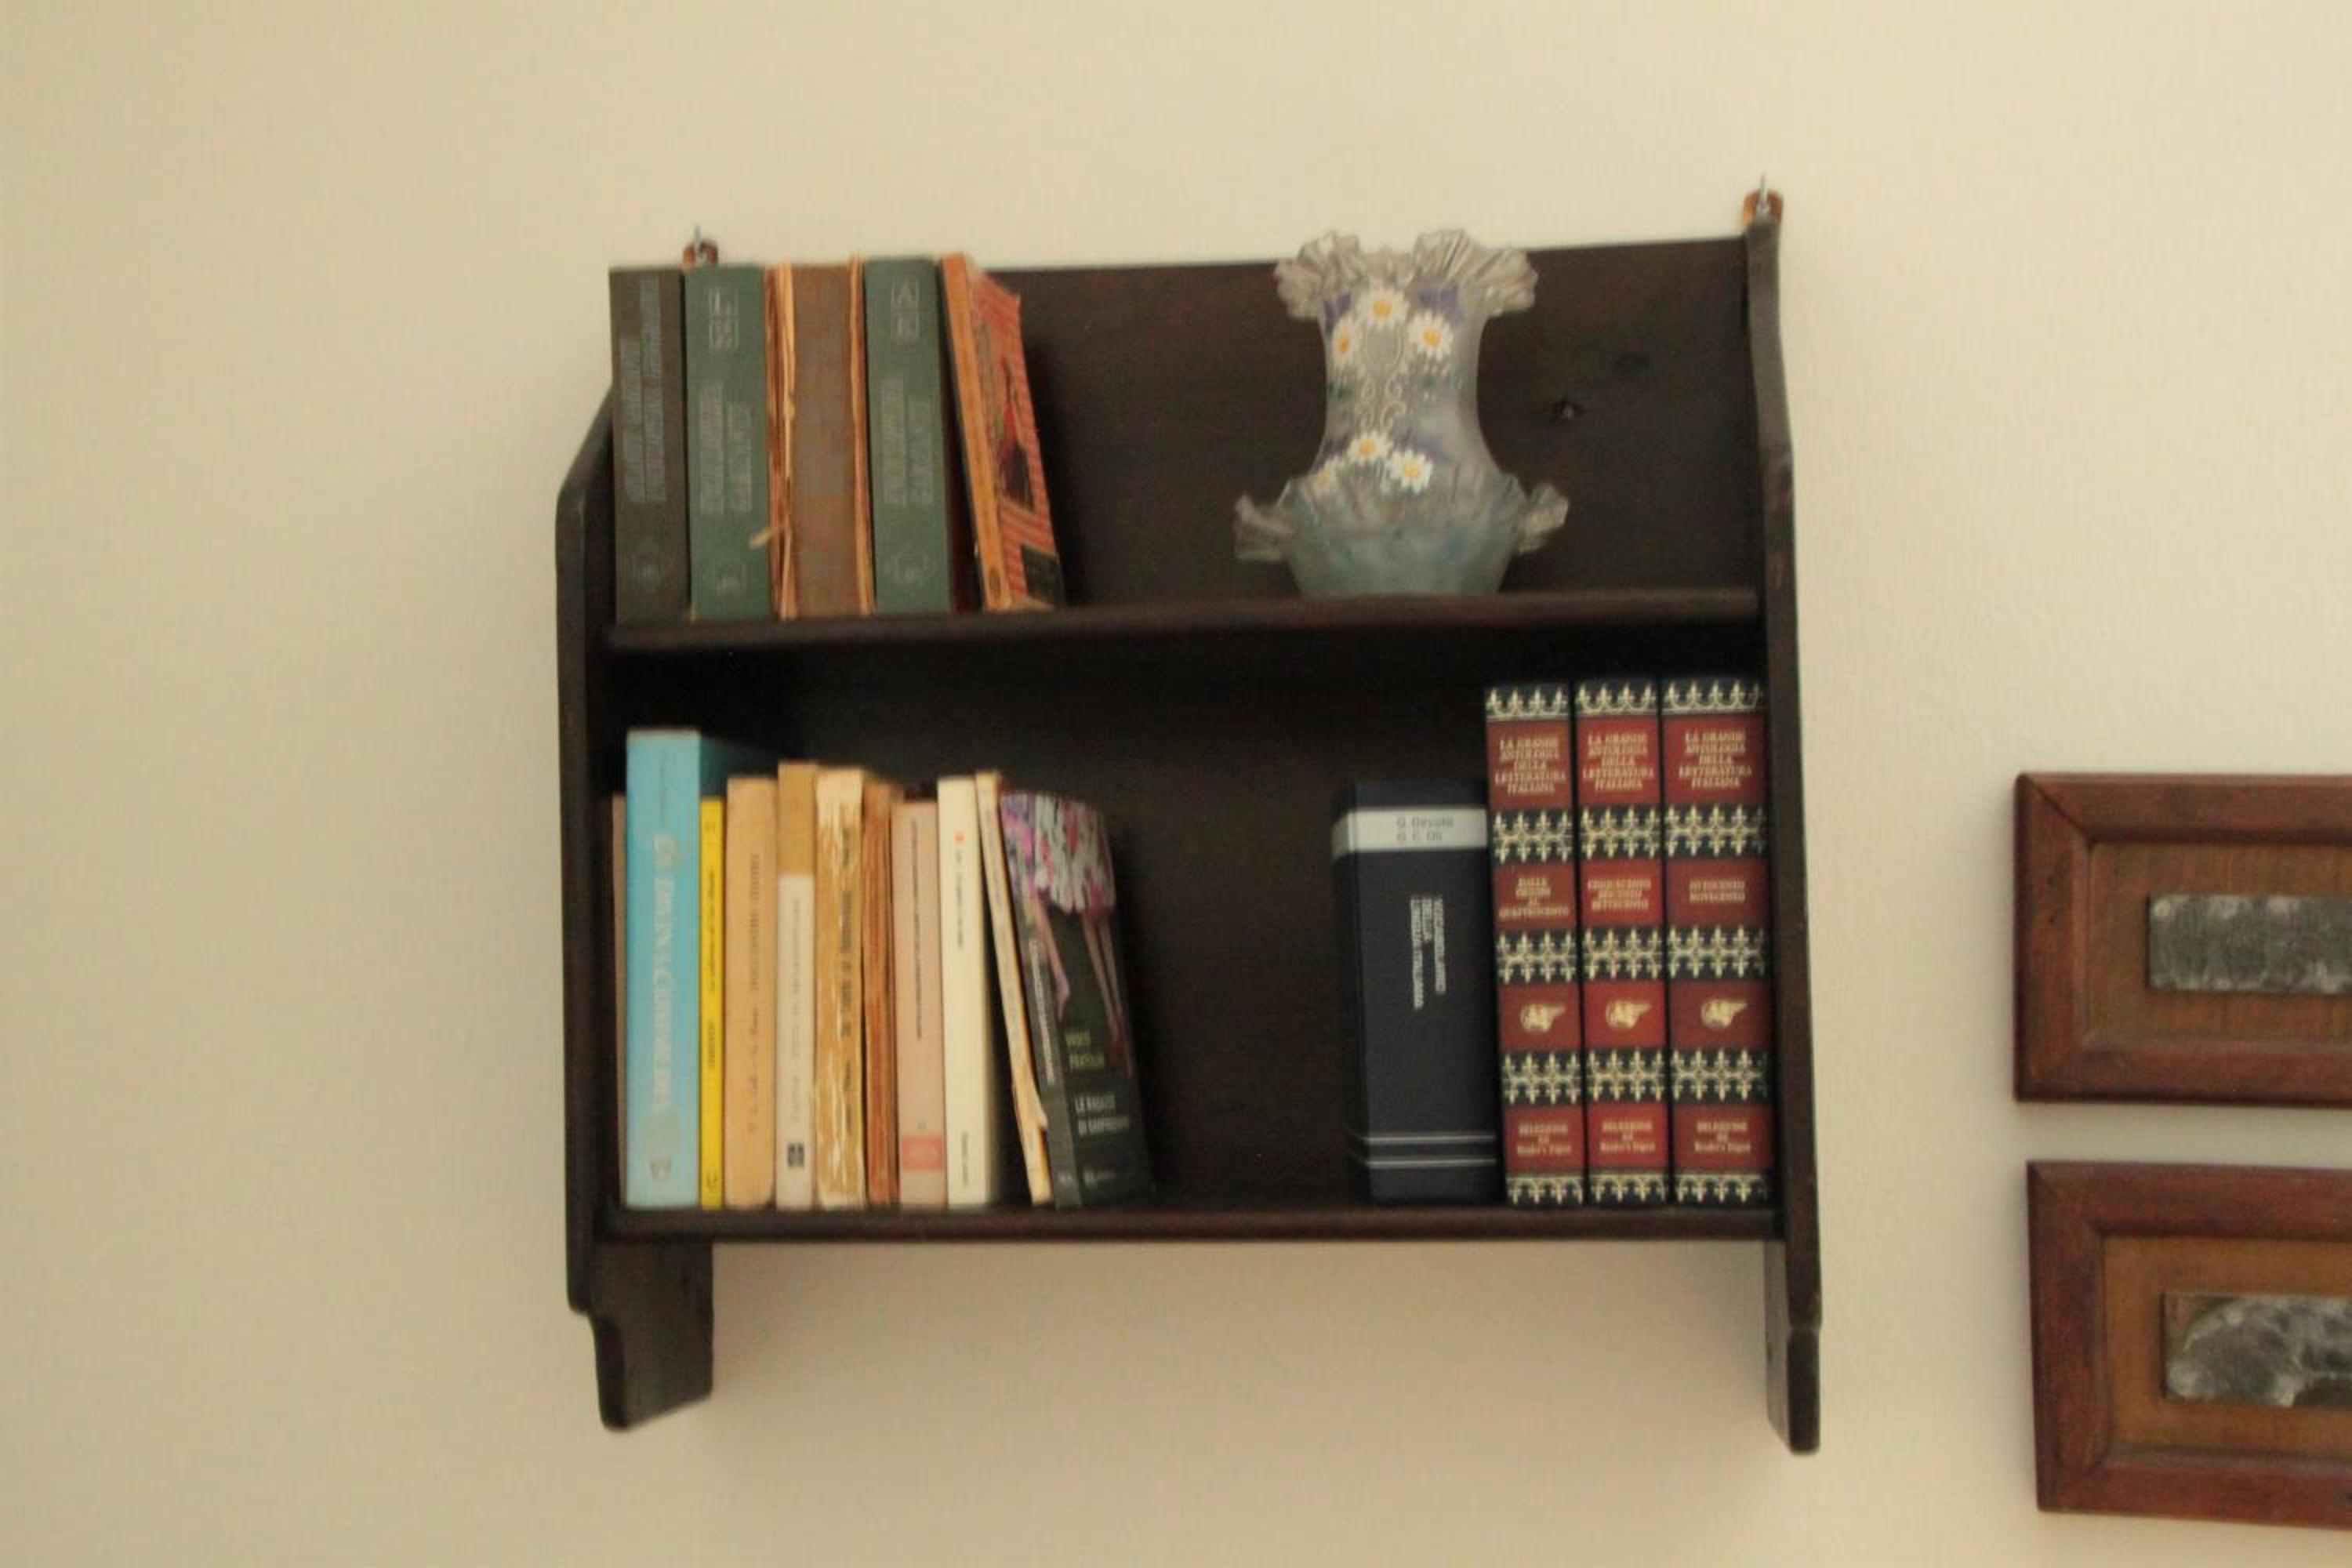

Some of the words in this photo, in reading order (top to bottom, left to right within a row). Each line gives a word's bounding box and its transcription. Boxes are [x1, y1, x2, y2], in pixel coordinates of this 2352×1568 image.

[1602, 755, 1635, 765] DELLA
[1699, 753, 1732, 764] DELLA
[1514, 760, 1547, 770] DELLA
[1495, 771, 1566, 784] LETTERATURA
[1583, 767, 1654, 779] LETTERATURA
[1679, 765, 1751, 778] LETTERATURA
[1508, 782, 1555, 795] ITALIANA
[1595, 778, 1642, 790] ITALIANA
[1692, 777, 1740, 789] ITALIANA
